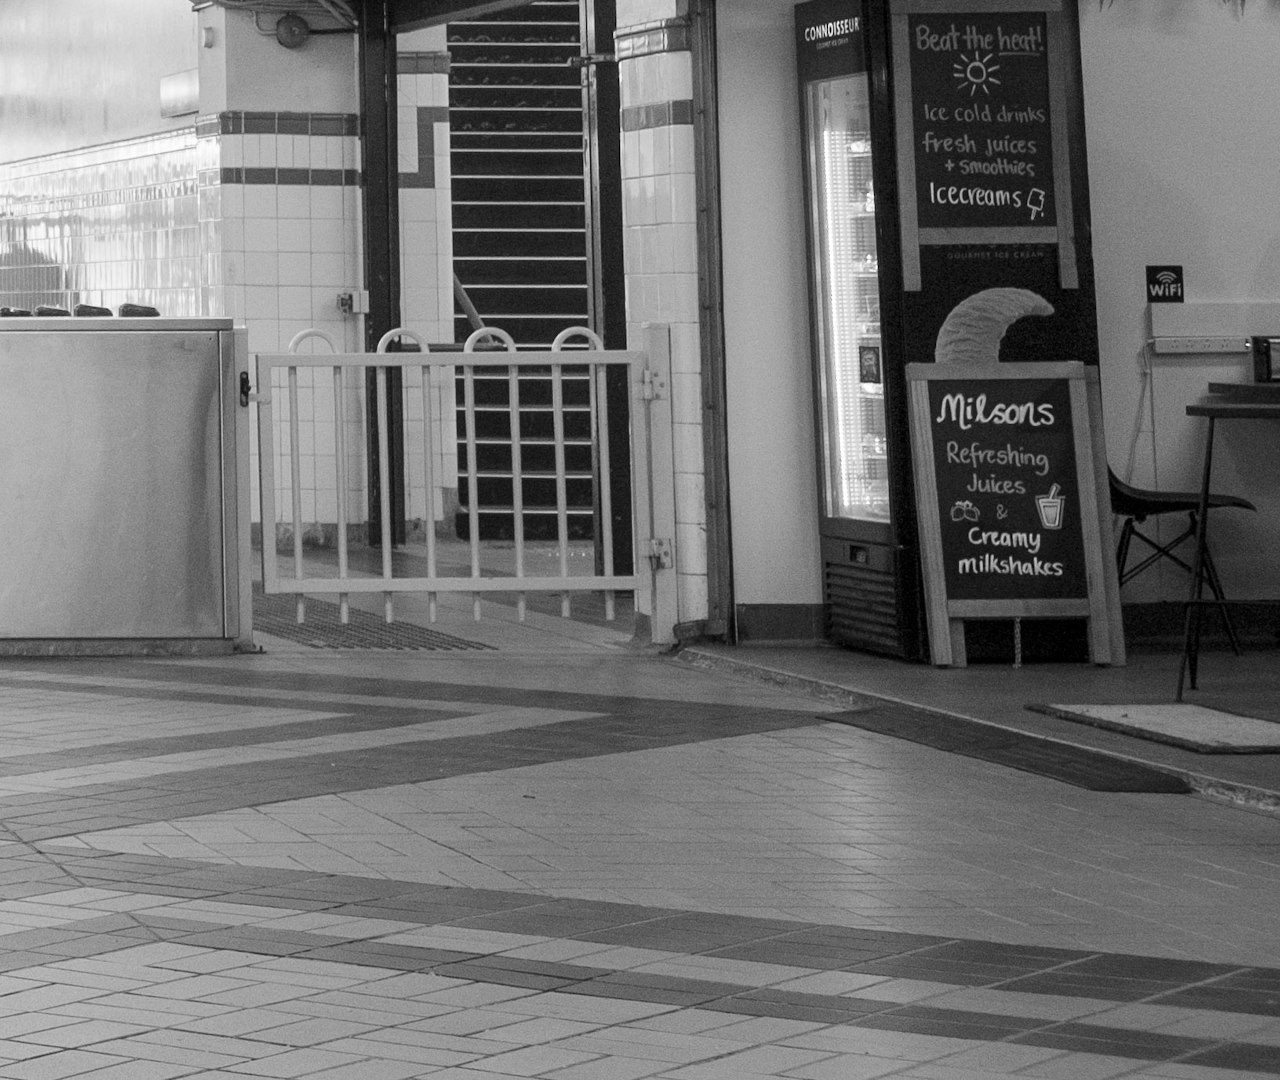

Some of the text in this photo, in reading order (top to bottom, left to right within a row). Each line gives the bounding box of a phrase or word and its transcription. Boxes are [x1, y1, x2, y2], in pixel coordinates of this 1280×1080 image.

[804, 17, 860, 42] CONNOISSEUR
[915, 23, 1045, 51] Beat the heat!
[924, 103, 1046, 124] Ice cold drinks
[922, 131, 1038, 157] fresh juices
[958, 157, 1036, 176] smoothies
[929, 181, 1022, 208] Icecreams
[1149, 282, 1182, 297] WiFi
[936, 392, 1055, 430] Milsons
[946, 441, 1050, 476] Refreshing
[967, 473, 1027, 495] Juices
[996, 504, 1009, 520] &
[968, 526, 1041, 554] Creamy
[958, 553, 1064, 577] milkshakes
